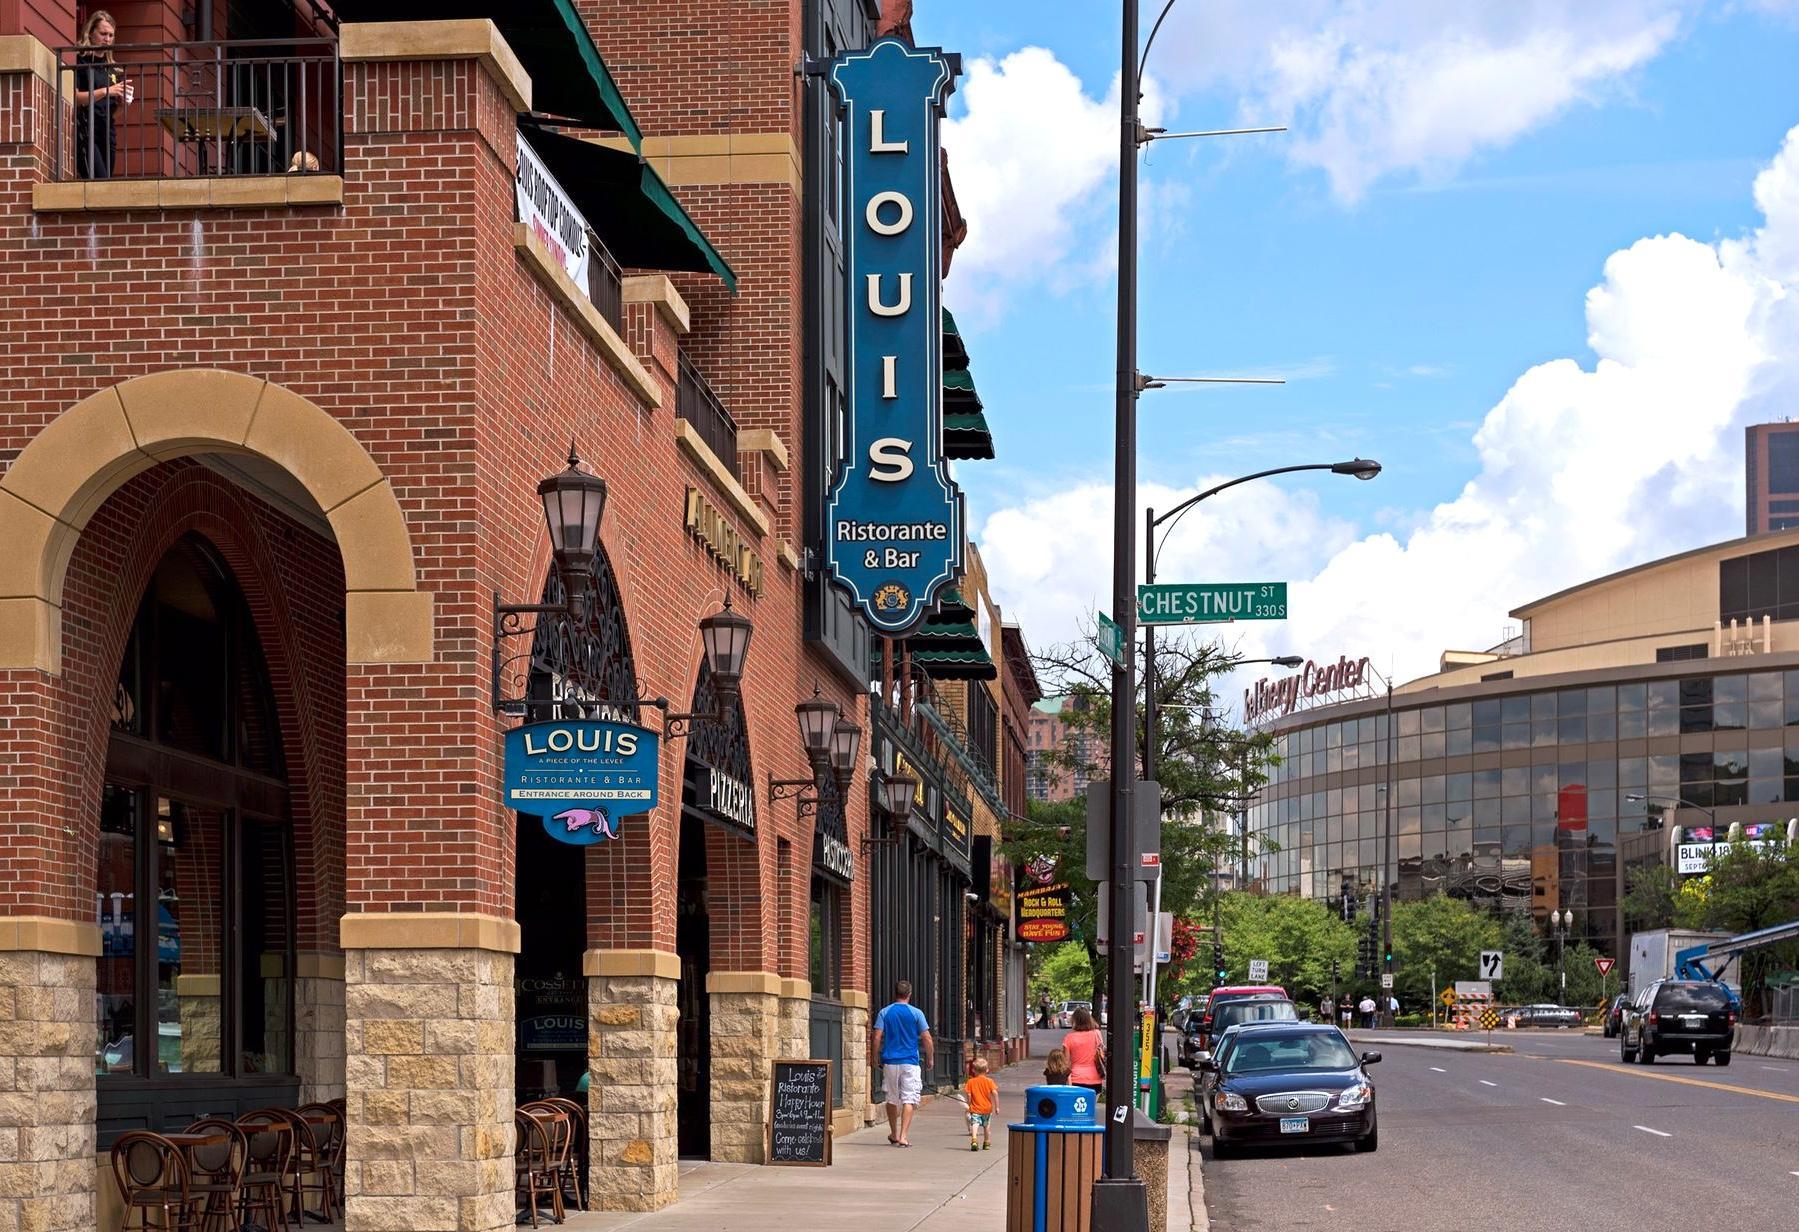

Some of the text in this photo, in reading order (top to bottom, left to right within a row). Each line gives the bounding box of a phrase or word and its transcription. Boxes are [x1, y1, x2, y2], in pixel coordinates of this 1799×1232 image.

[865, 109, 914, 483] LOUIS
[837, 520, 947, 543] Ristorante
[864, 548, 920, 569] & Bar
[1261, 586, 1274, 598] ST
[1142, 591, 1255, 615] CHESTNUT
[1303, 655, 1370, 698] Center
[524, 729, 639, 756] LOUIS
[603, 776, 611, 784] &
[618, 775, 641, 784] BAR
[519, 790, 571, 798] ENTRANCE
[617, 790, 643, 798] BACK
[710, 767, 754, 828] PIZZERIA
[1023, 897, 1040, 907] ROCK
[1048, 897, 1062, 906] ROLL
[1021, 908, 1065, 918] HEADQUARTERS
[534, 1018, 585, 1030] LOUIS
[788, 1067, 816, 1083] Louis
[778, 1082, 820, 1094] Ristorante
[780, 1094, 825, 1112] Happy Hour
[775, 1132, 797, 1145] Come
[776, 1145, 811, 1156] with us!
